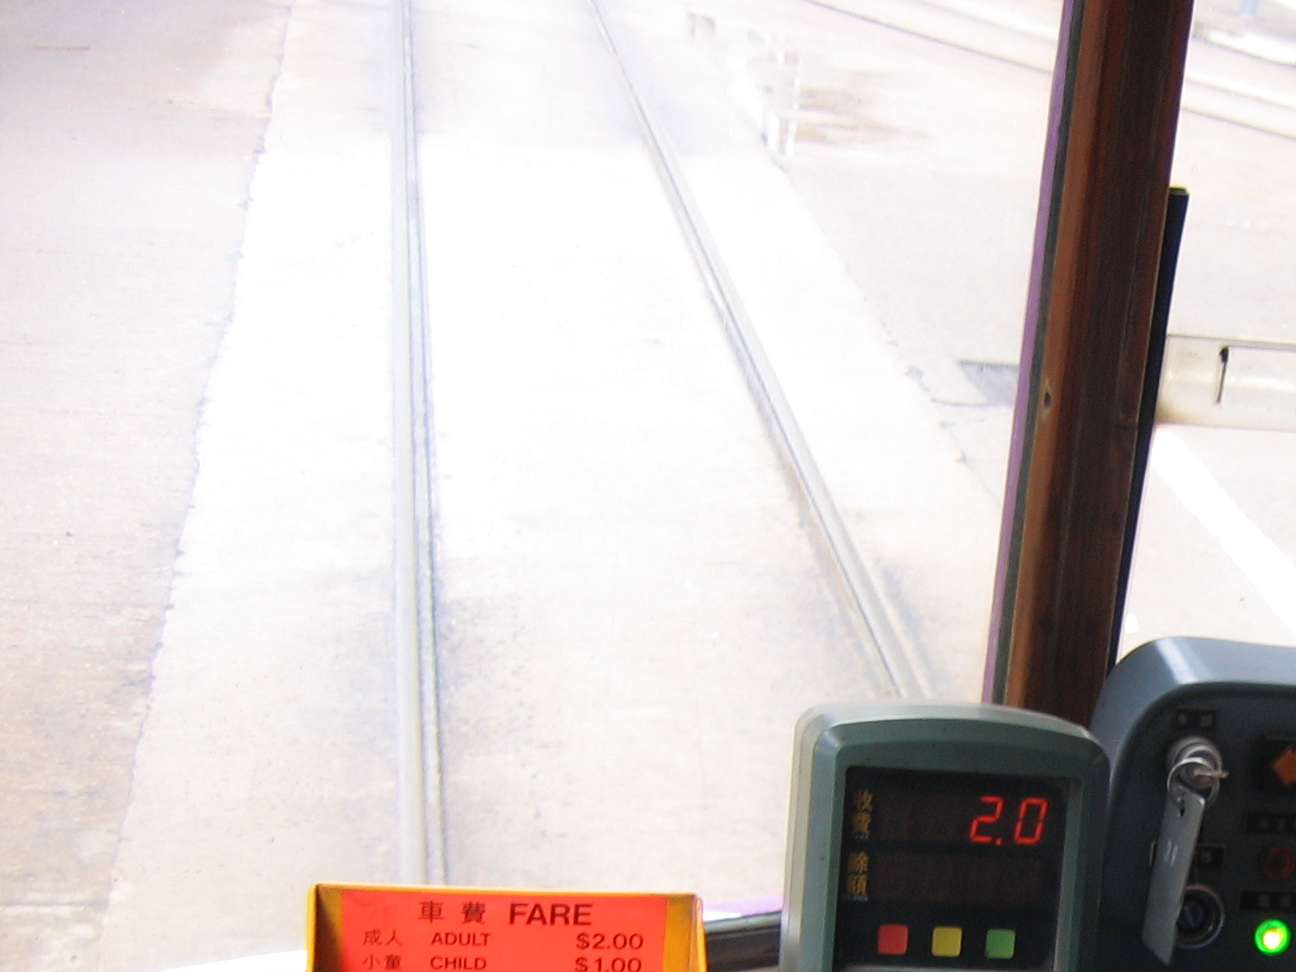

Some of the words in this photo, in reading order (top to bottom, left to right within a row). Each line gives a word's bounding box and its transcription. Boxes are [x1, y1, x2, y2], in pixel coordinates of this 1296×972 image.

[969, 795, 1050, 846] 2.0
[418, 900, 486, 925] 車費
[509, 902, 593, 926] FARE
[363, 929, 404, 947] 成人
[431, 932, 491, 947] ADULT
[576, 933, 645, 951] $2.00
[362, 954, 402, 971] 小童
[430, 956, 487, 971] CHILD
